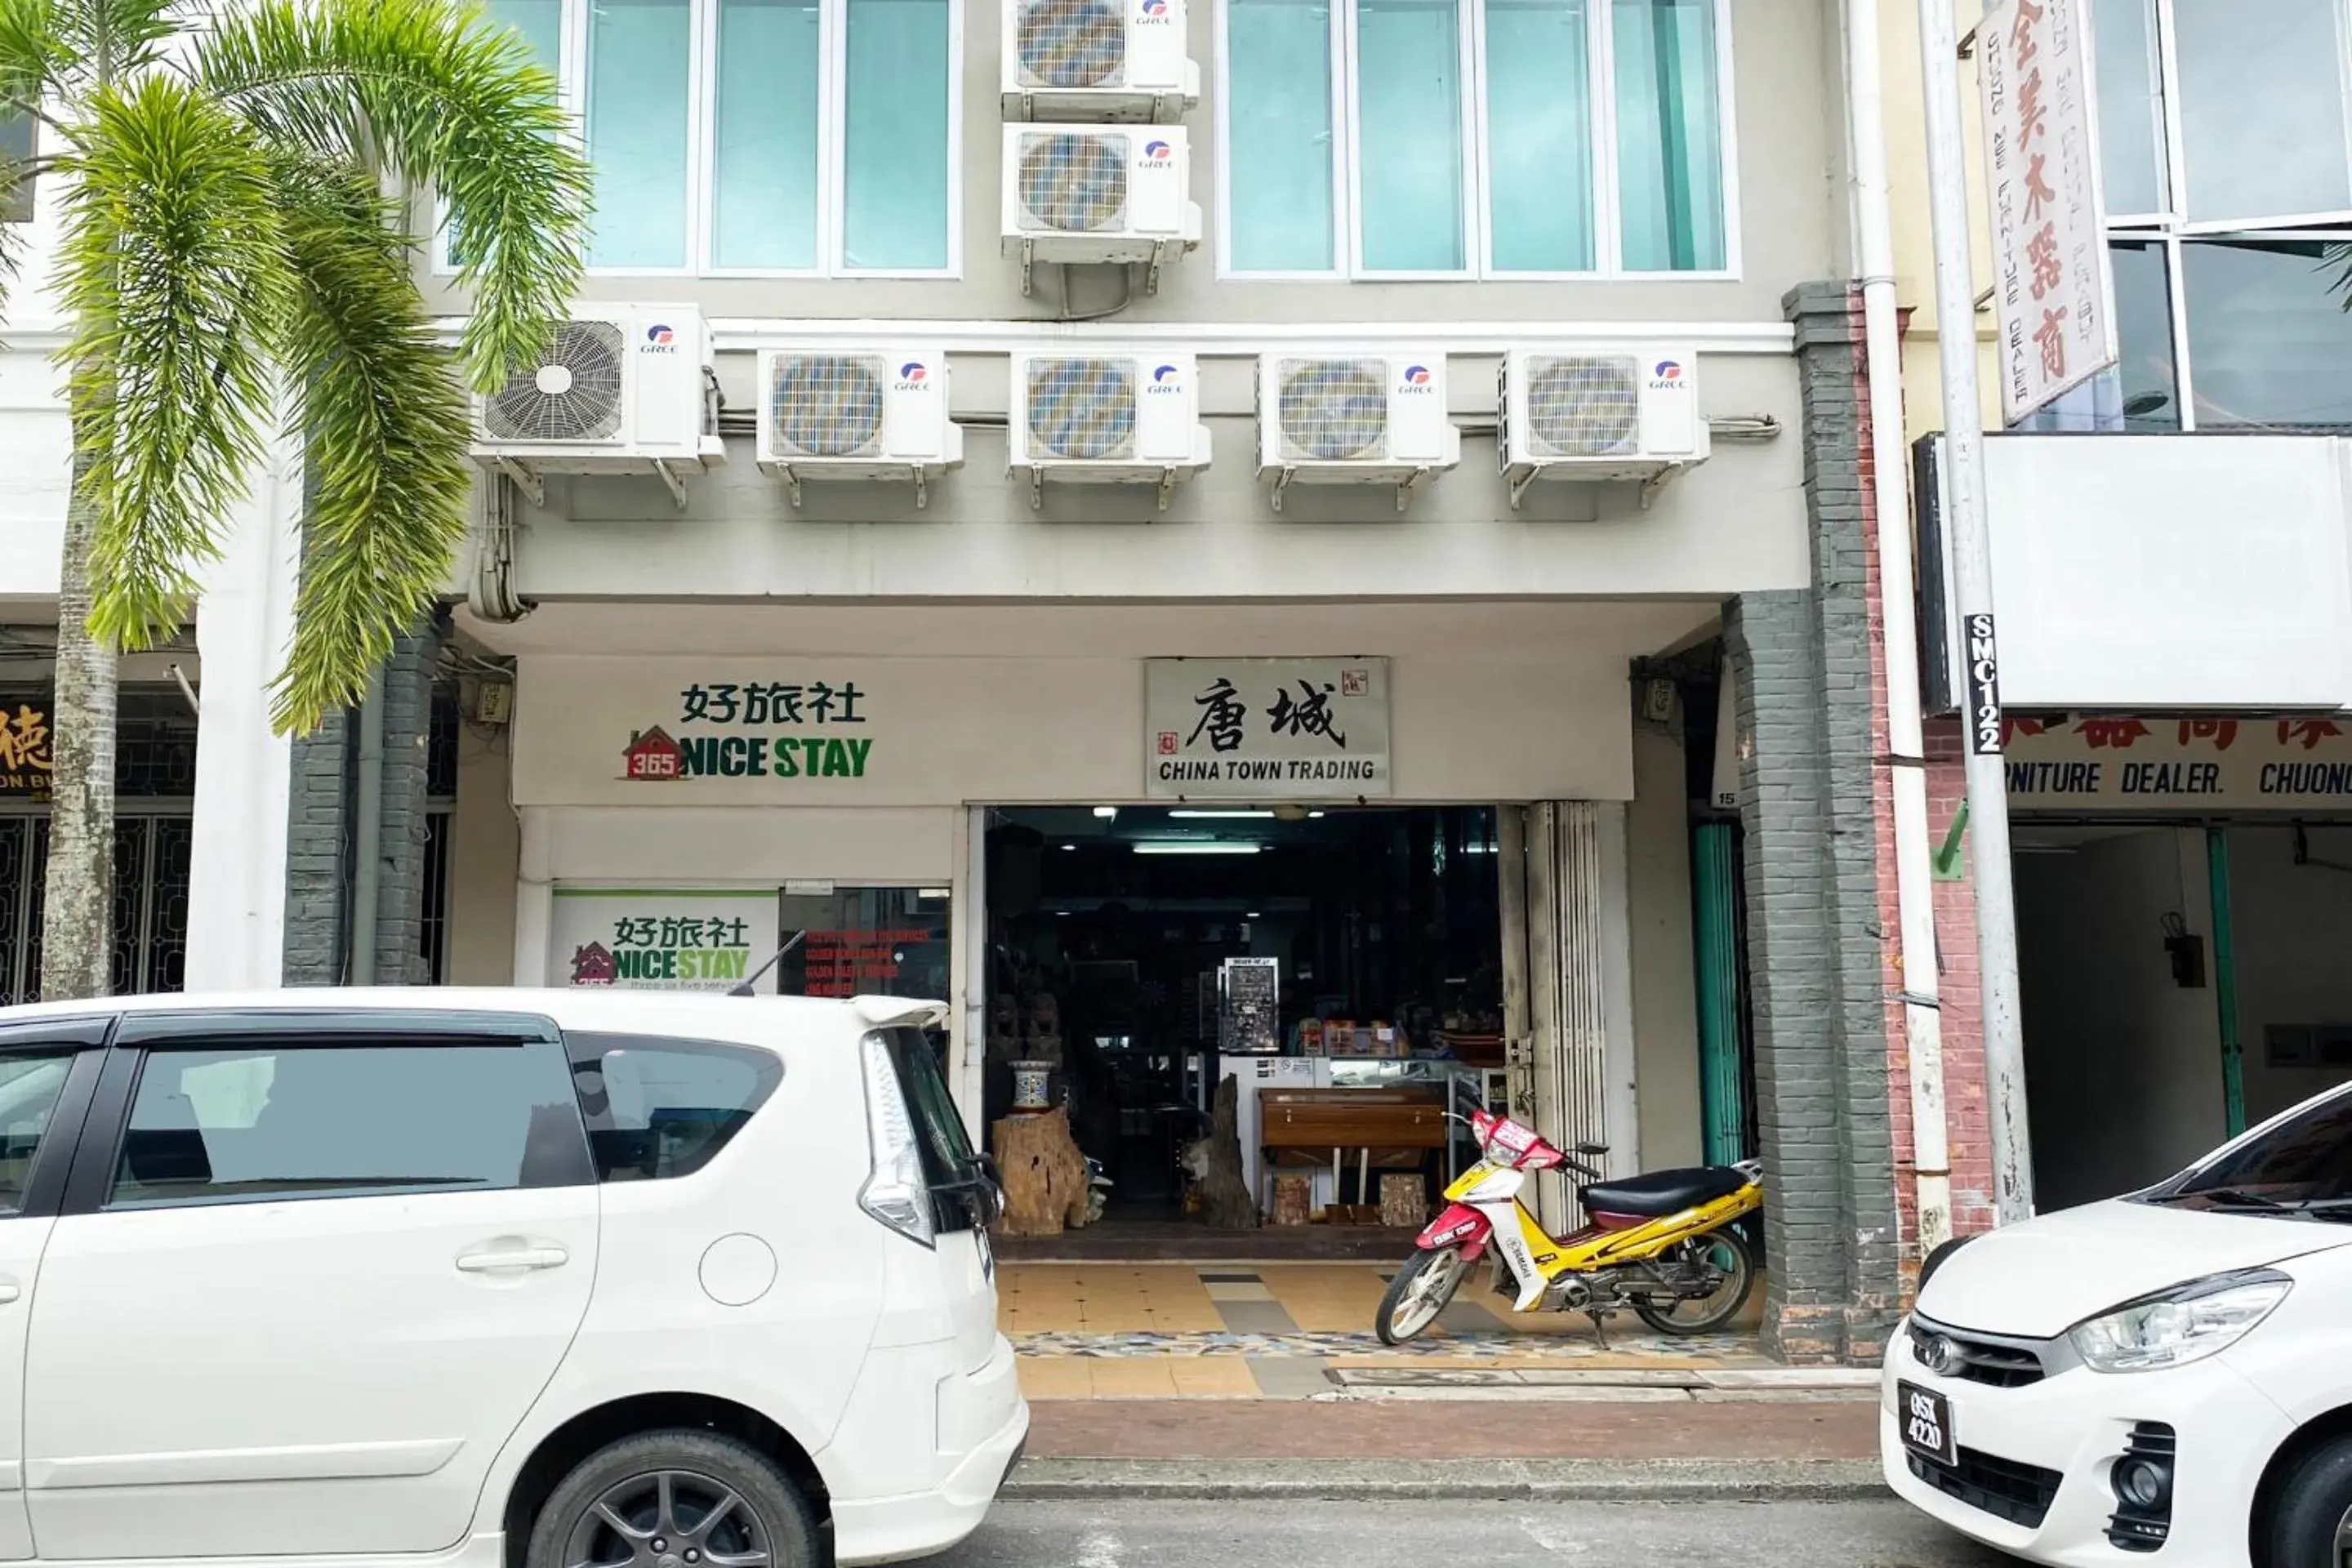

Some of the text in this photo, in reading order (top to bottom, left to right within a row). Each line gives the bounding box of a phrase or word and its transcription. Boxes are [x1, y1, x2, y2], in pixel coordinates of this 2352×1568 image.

[640, 344, 679, 354] GREE
[2008, 317, 2028, 404] DEALER
[1971, 614, 2000, 752] SMC122
[679, 681, 866, 724] 好旅社
[1185, 677, 1346, 753] 唐城
[632, 753, 676, 775] 365
[679, 736, 874, 777] NICE STAY
[1159, 760, 1374, 780] CHINA TOWN TRADING
[2120, 762, 2225, 793] DEALER.
[1718, 792, 1736, 805] 15
[612, 916, 751, 948] 好旅社
[612, 949, 751, 979] NICE STAY
